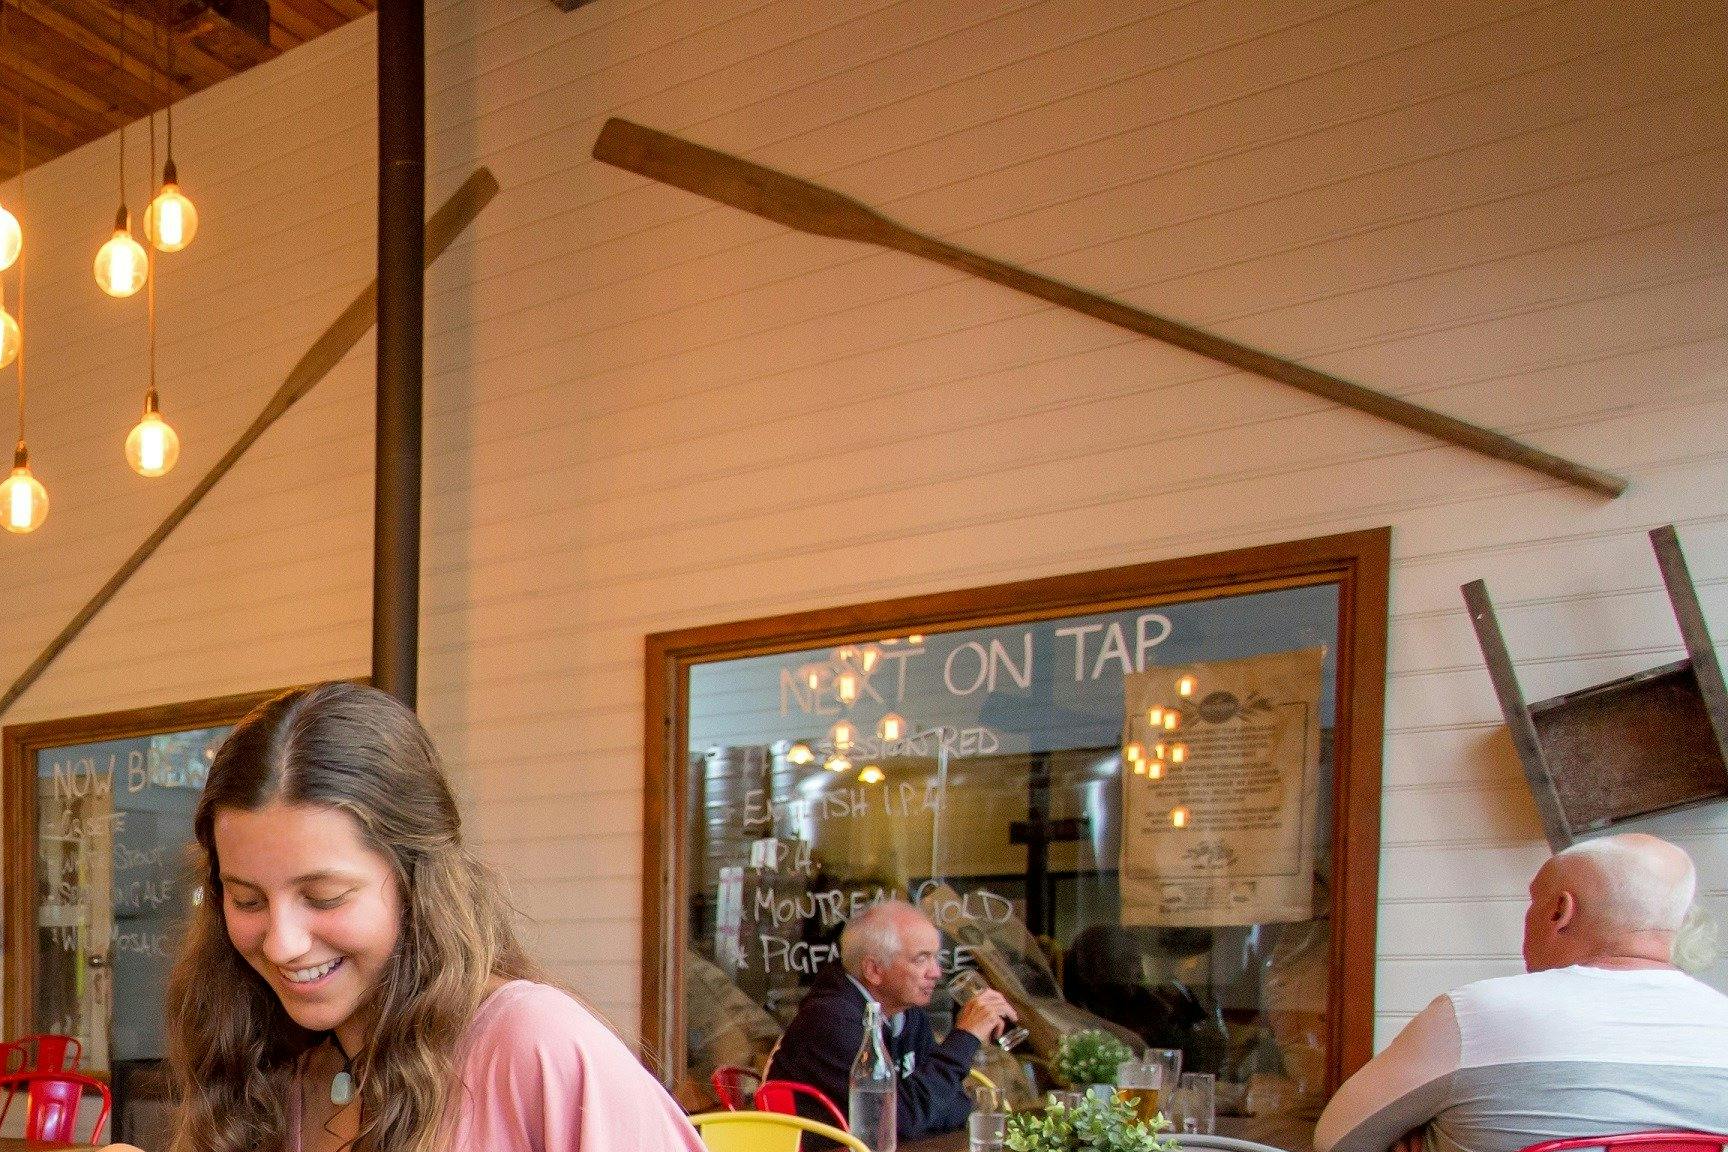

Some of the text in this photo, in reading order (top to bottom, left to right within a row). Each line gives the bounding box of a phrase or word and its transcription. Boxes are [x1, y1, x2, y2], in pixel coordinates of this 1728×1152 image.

[779, 613, 1173, 718] NEXT ON TAP
[53, 754, 117, 800] NOW
